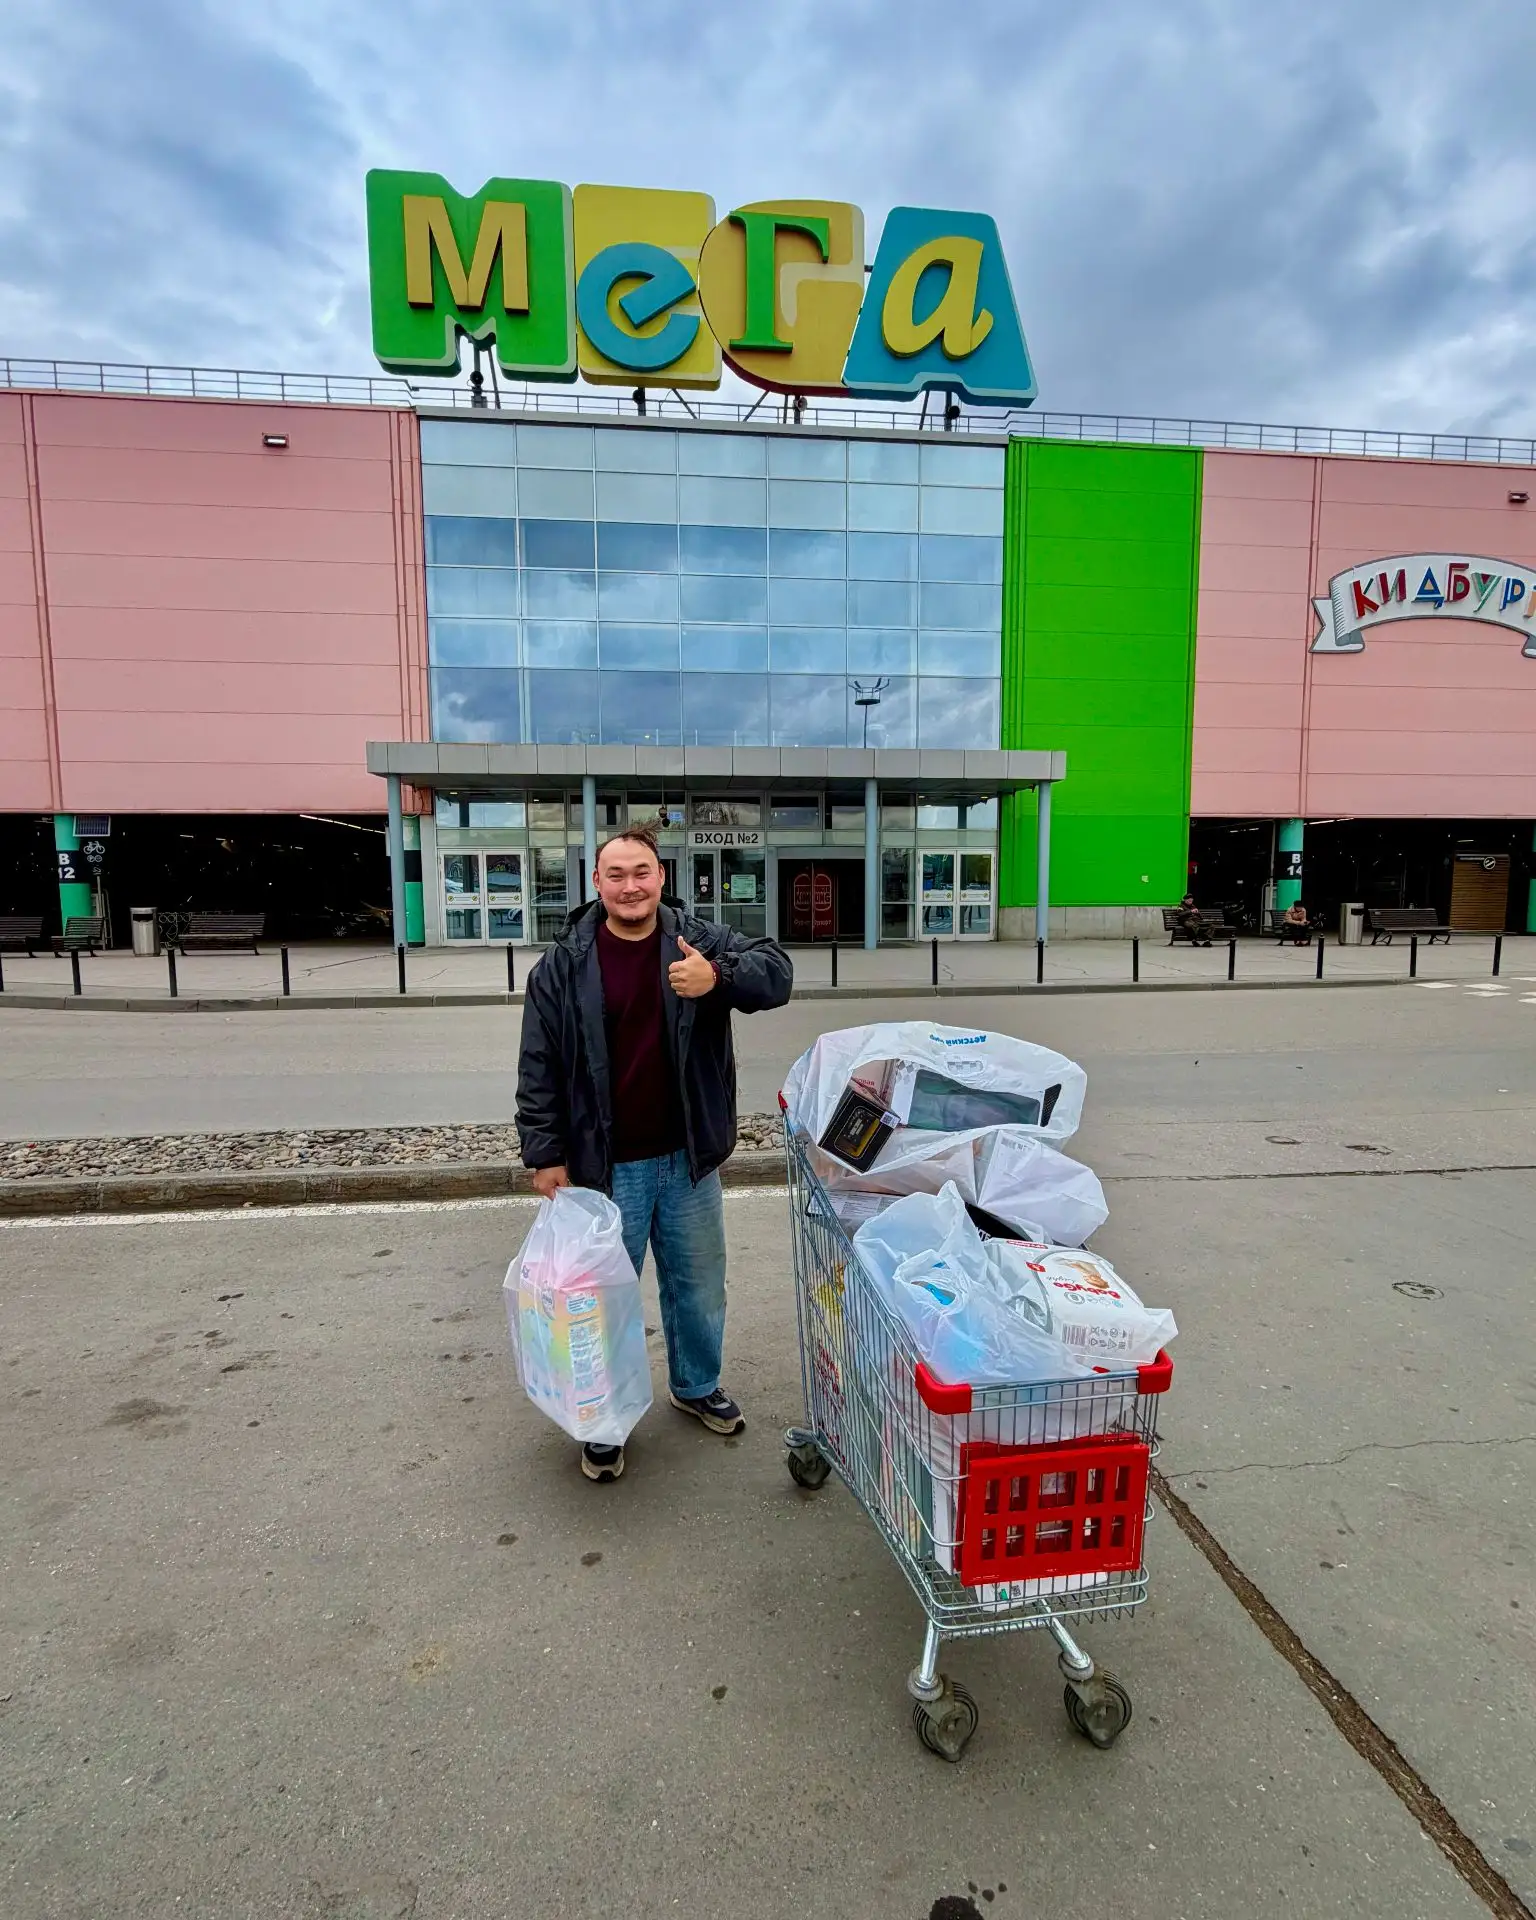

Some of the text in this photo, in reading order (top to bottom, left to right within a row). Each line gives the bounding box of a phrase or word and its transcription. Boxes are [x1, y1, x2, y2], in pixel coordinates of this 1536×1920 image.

[694, 832, 759, 846] ВХОД №2
[58, 866, 76, 879] 12
[1287, 865, 1302, 876] 14
